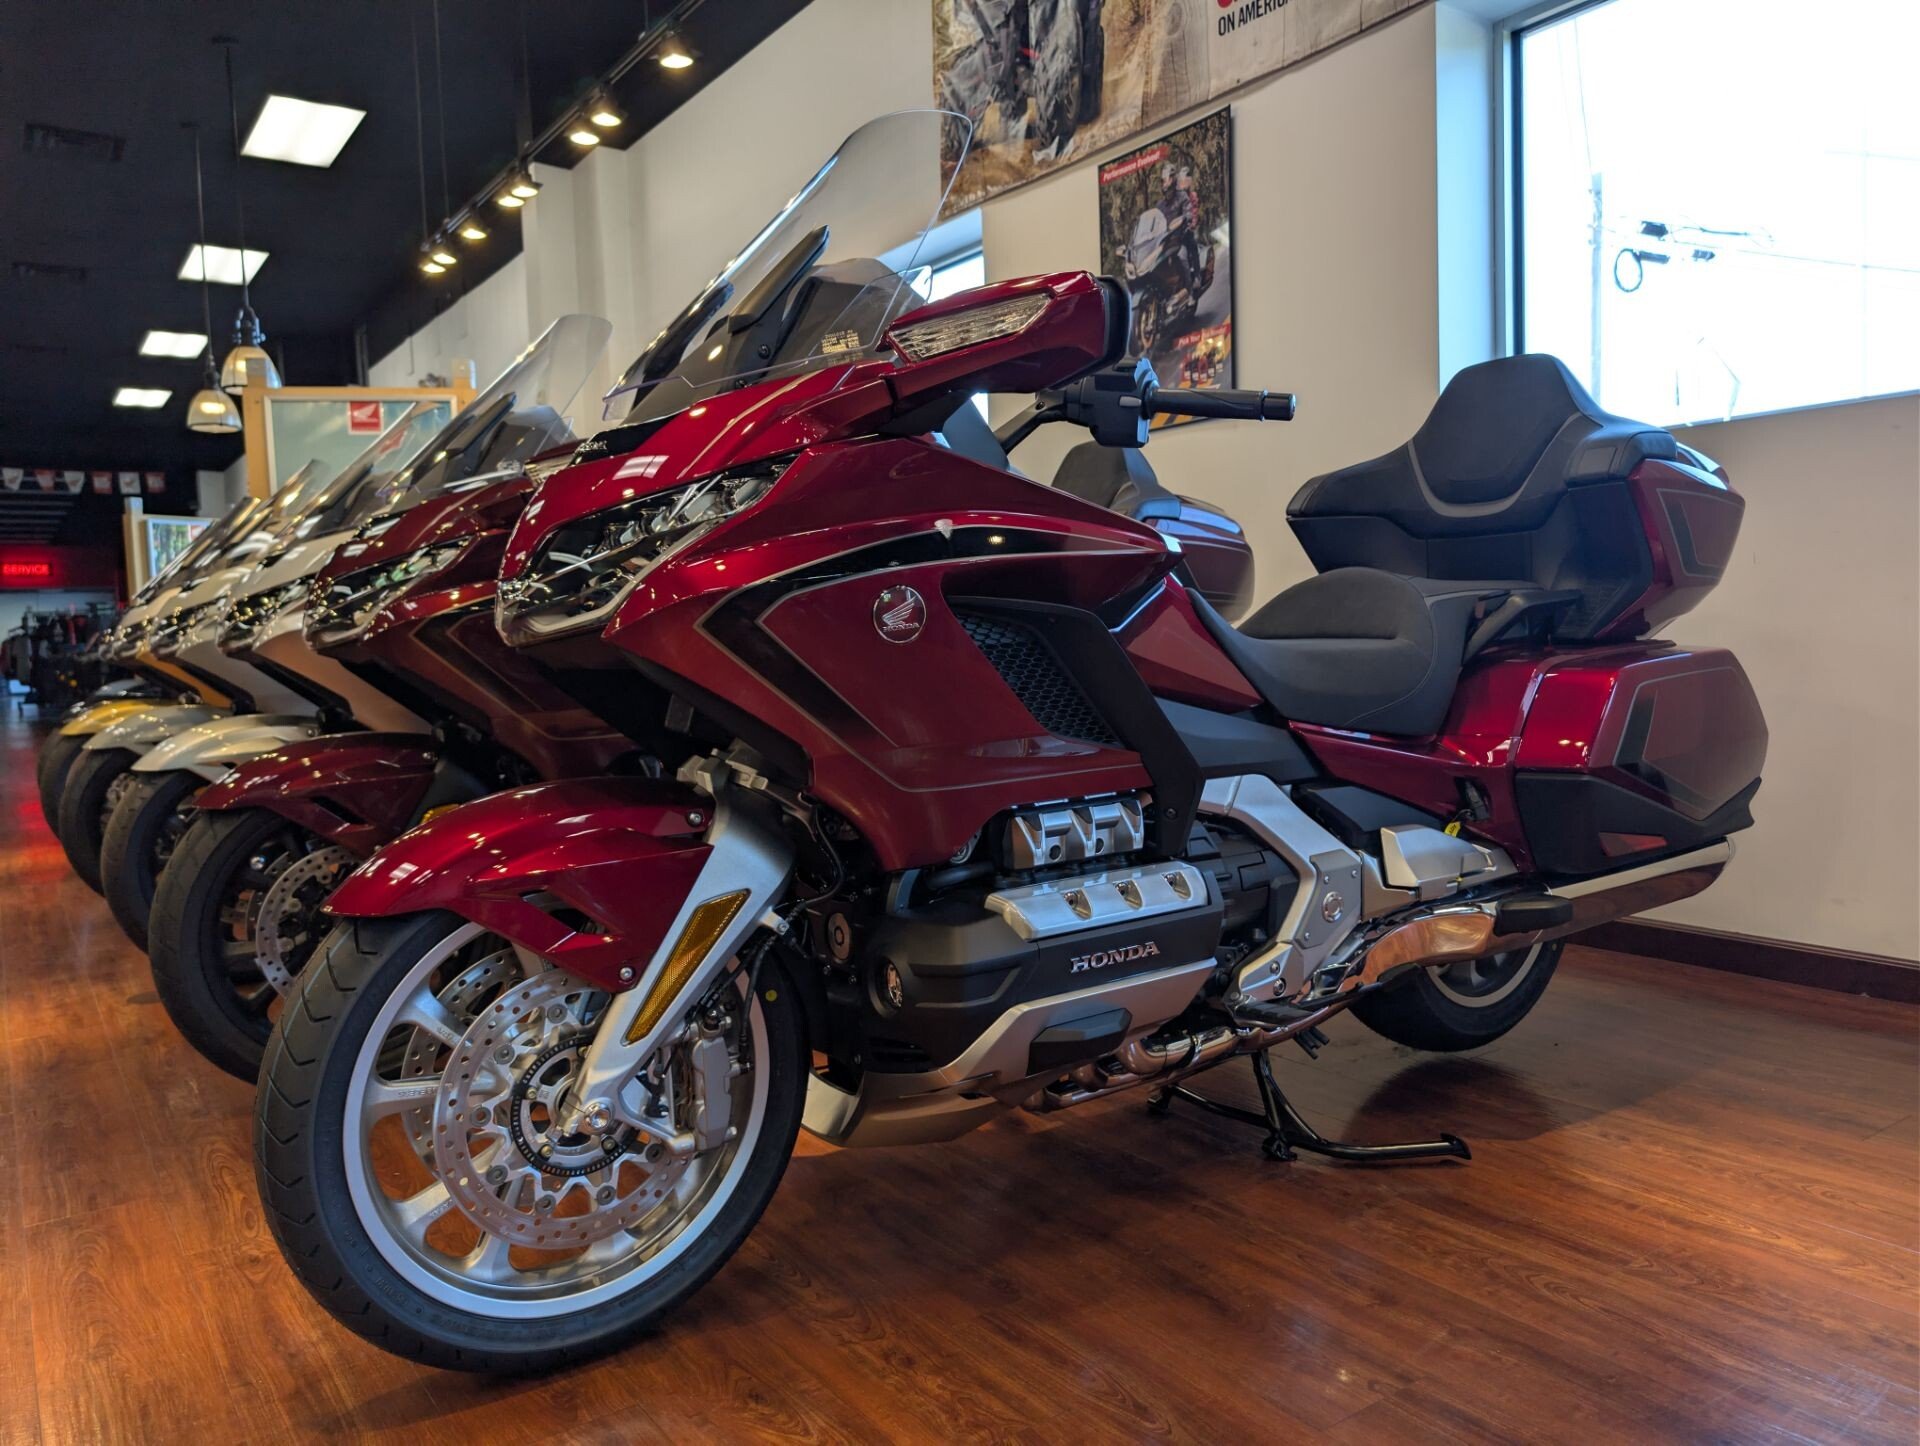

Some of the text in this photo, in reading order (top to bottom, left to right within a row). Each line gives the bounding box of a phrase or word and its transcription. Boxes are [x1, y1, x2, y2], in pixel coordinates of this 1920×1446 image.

[1218, 0, 1289, 36] ON AMERI
[3, 564, 49, 576] SERVICE
[1070, 941, 1160, 973] HONDA
